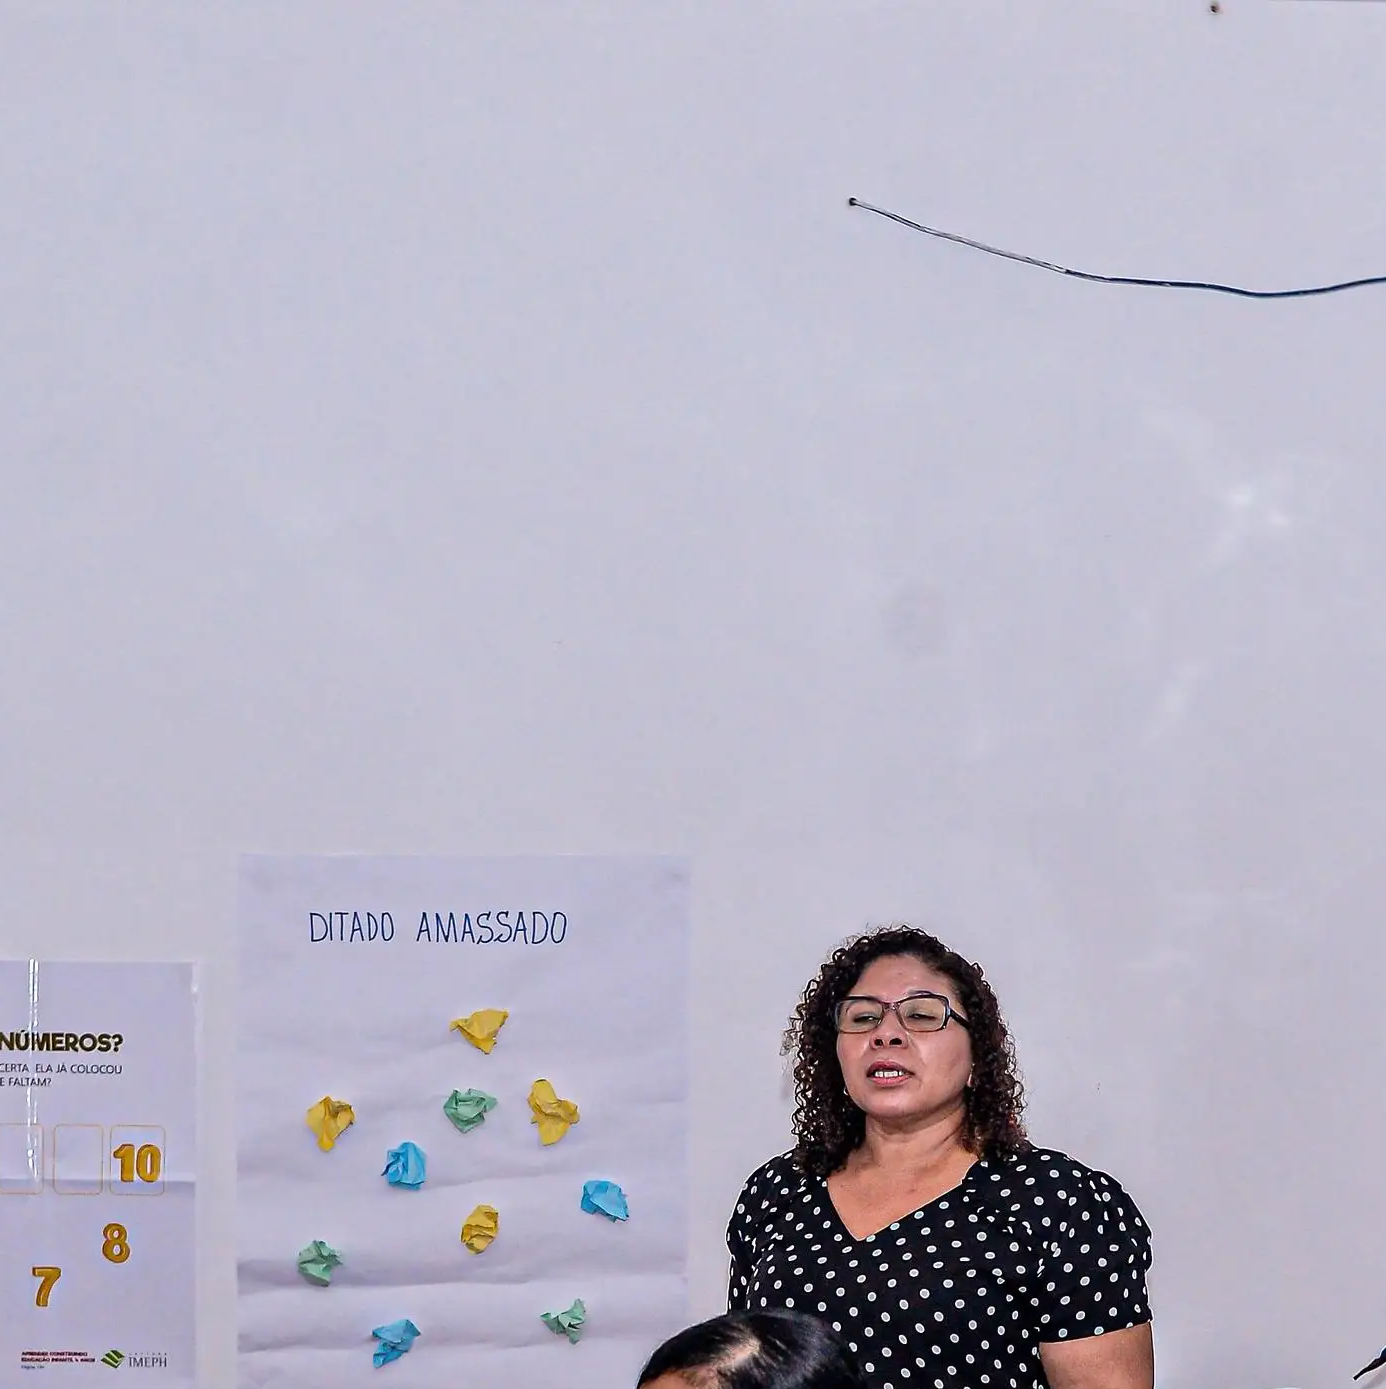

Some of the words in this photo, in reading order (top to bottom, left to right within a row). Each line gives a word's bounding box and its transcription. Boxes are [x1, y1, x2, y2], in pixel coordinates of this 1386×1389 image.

[309, 912, 395, 942] DITADO
[416, 910, 567, 945] AMASSADO
[8, 1077, 52, 1087] FALTAM?
[35, 1063, 53, 1073] ELA
[56, 1062, 66, 1074] JÁ
[70, 1064, 122, 1075] COLOCOU
[112, 1142, 162, 1183] 10
[102, 1222, 131, 1264] 8
[31, 1265, 62, 1308] 7
[128, 1357, 168, 1368] IMEPH
